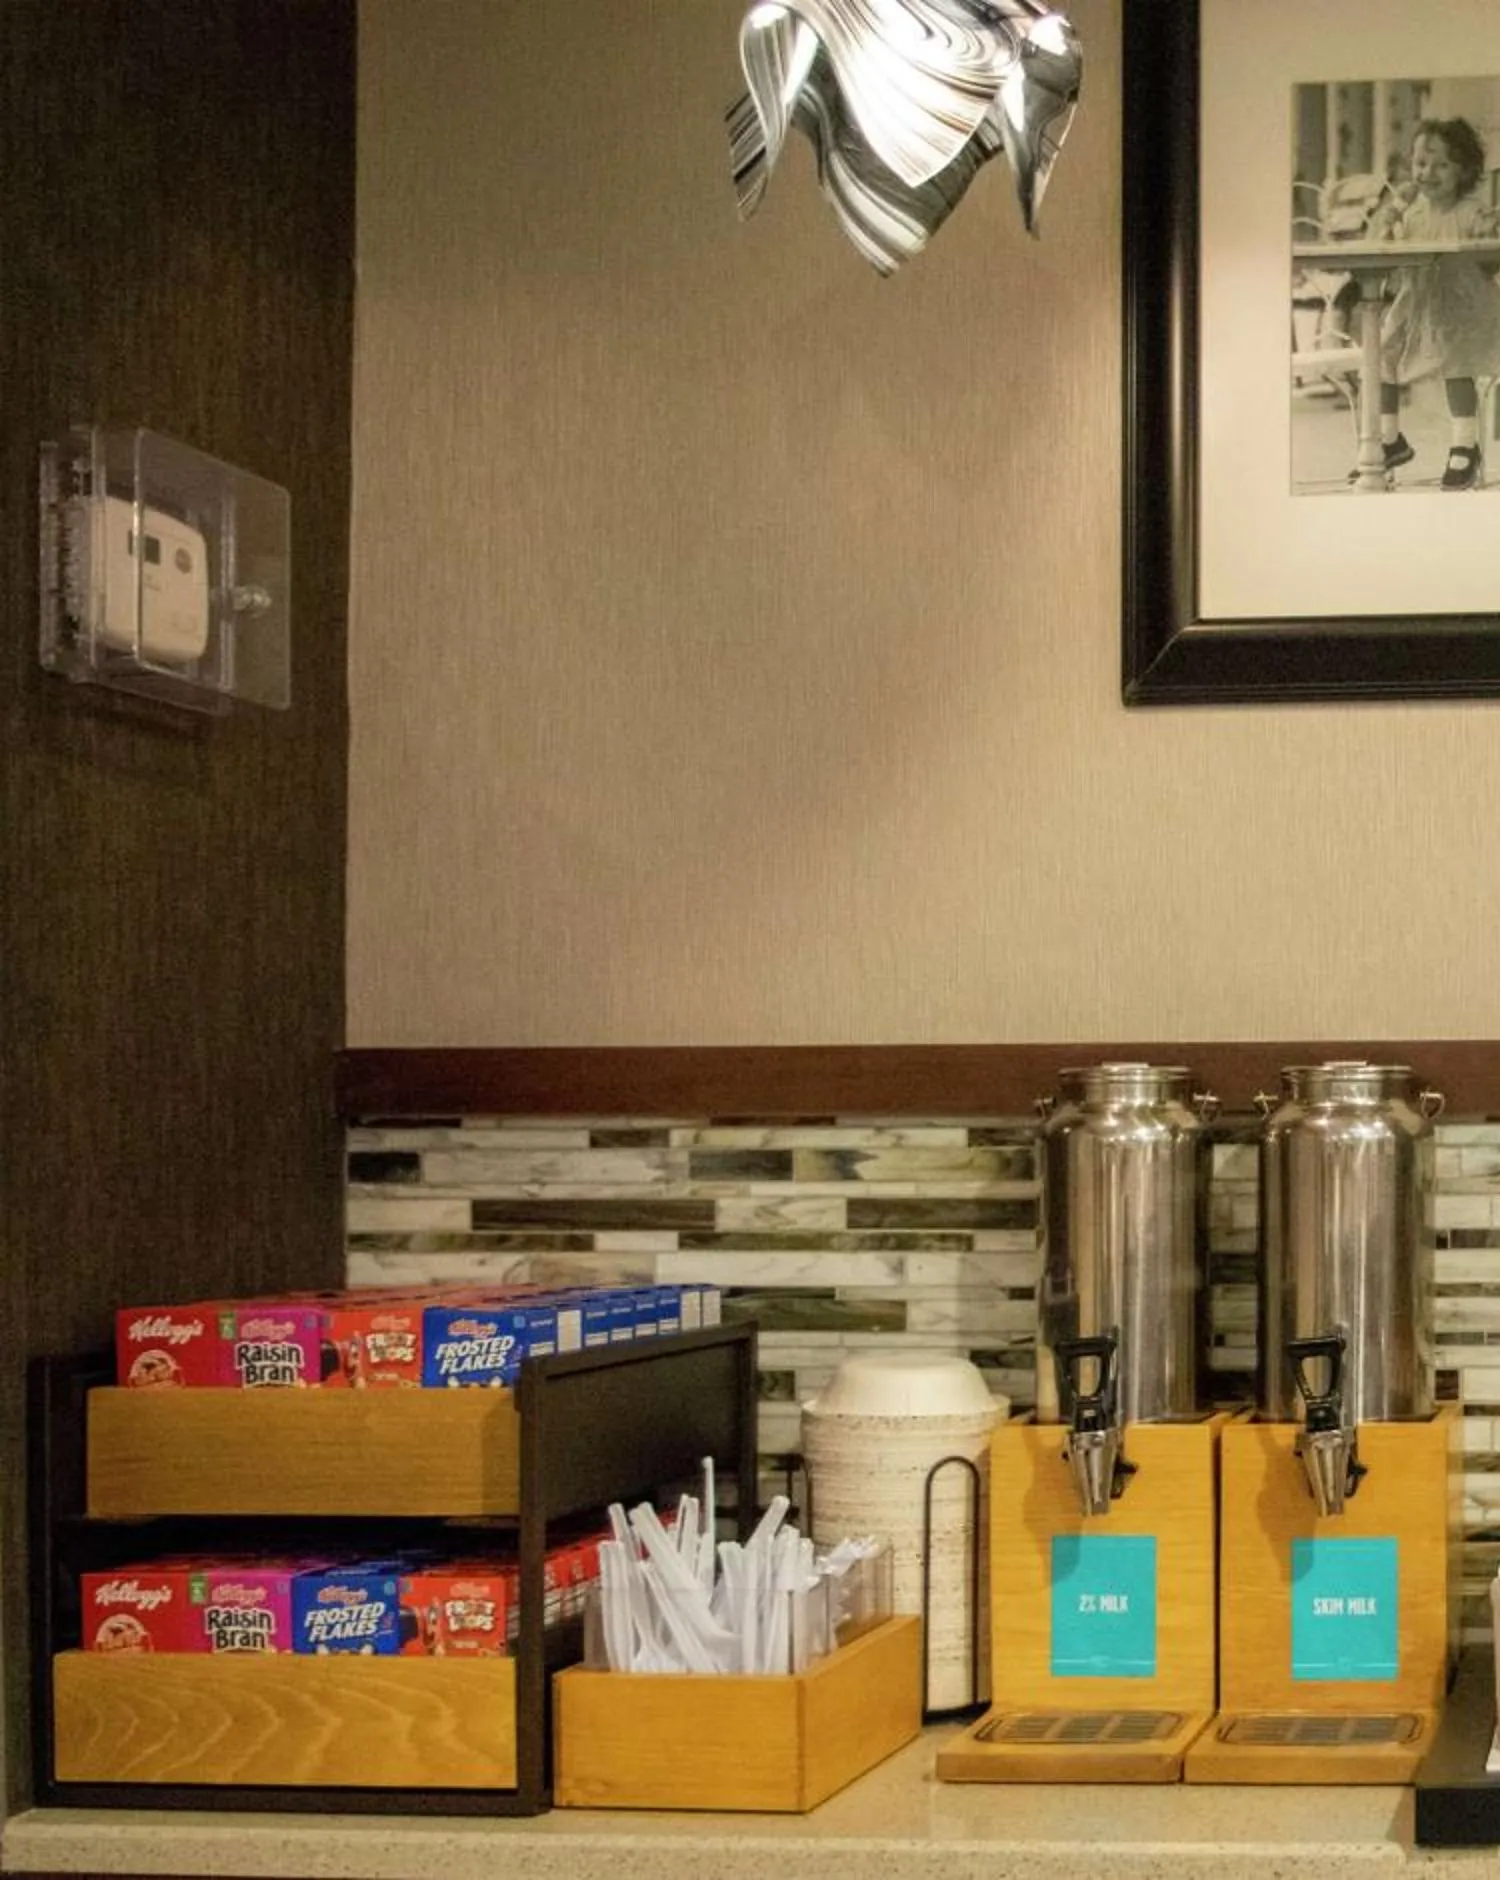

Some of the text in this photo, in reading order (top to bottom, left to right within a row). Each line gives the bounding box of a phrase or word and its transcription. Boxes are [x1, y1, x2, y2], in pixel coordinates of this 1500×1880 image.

[128, 1316, 205, 1344] Kellogg's
[236, 1344, 303, 1367] Raisin
[434, 1335, 515, 1361] FROSTED
[243, 1364, 296, 1383] Bran
[440, 1351, 507, 1375] FLAKES
[95, 1579, 173, 1610] Kellogg's
[1099, 1593, 1129, 1612] MILK
[1312, 1597, 1378, 1615] SKIM MILK
[206, 1608, 272, 1630] Raisin
[304, 1602, 386, 1628] FROSTED
[215, 1627, 266, 1649] Bran
[309, 1619, 378, 1643] FLAKES
